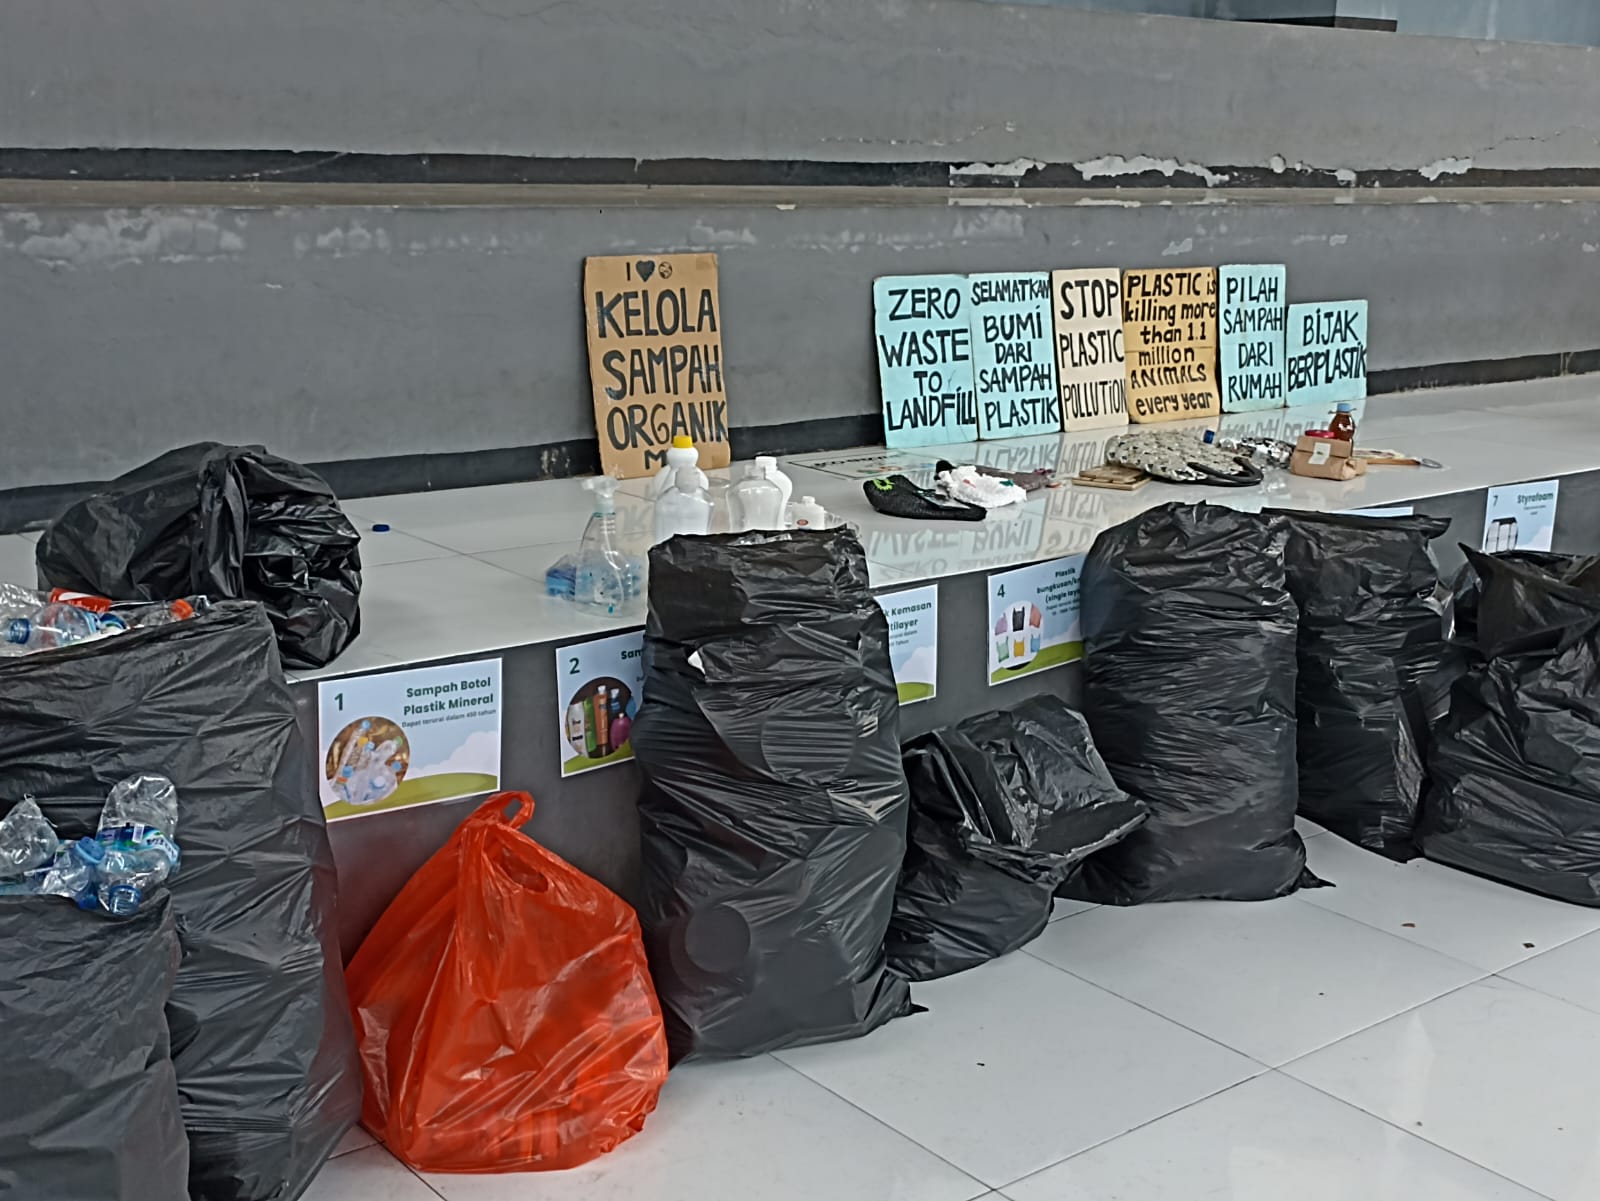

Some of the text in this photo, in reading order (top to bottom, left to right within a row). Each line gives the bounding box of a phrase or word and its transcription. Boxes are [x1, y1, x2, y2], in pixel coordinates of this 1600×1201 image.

[1127, 272, 1202, 298] PLASTIC
[1226, 275, 1279, 304] PILAH
[888, 287, 960, 321] ZERO
[1060, 278, 1119, 320] STOP
[595, 287, 717, 339] KELOLA
[1125, 299, 1216, 327] killing more
[1223, 307, 1283, 335] SAMPAH
[879, 328, 969, 368] WASTE
[1059, 329, 1125, 368] PLASTIC
[1140, 326, 1182, 345] than
[995, 341, 1032, 365] DARI
[1138, 347, 1195, 366] million
[1238, 341, 1273, 368] DARI
[602, 344, 722, 400] SAMPAH
[913, 371, 942, 396] TO
[980, 364, 1052, 393] SAMPAH
[1228, 372, 1282, 402] RUMAH
[984, 397, 1059, 431] PLASTIK
[1135, 390, 1213, 416] every year
[607, 400, 729, 451] ORGANIK
[1493, 494, 1499, 506] 7
[1517, 492, 1554, 505] Styrofoam
[1055, 567, 1076, 578] Plastik
[997, 584, 1005, 598] 4
[891, 601, 932, 617] Kemasan
[890, 618, 919, 632] tilayer
[569, 657, 580, 675] 2
[406, 677, 491, 698] Sampah Botol
[334, 693, 344, 712] 1
[403, 693, 494, 716] Plastik Mineral
